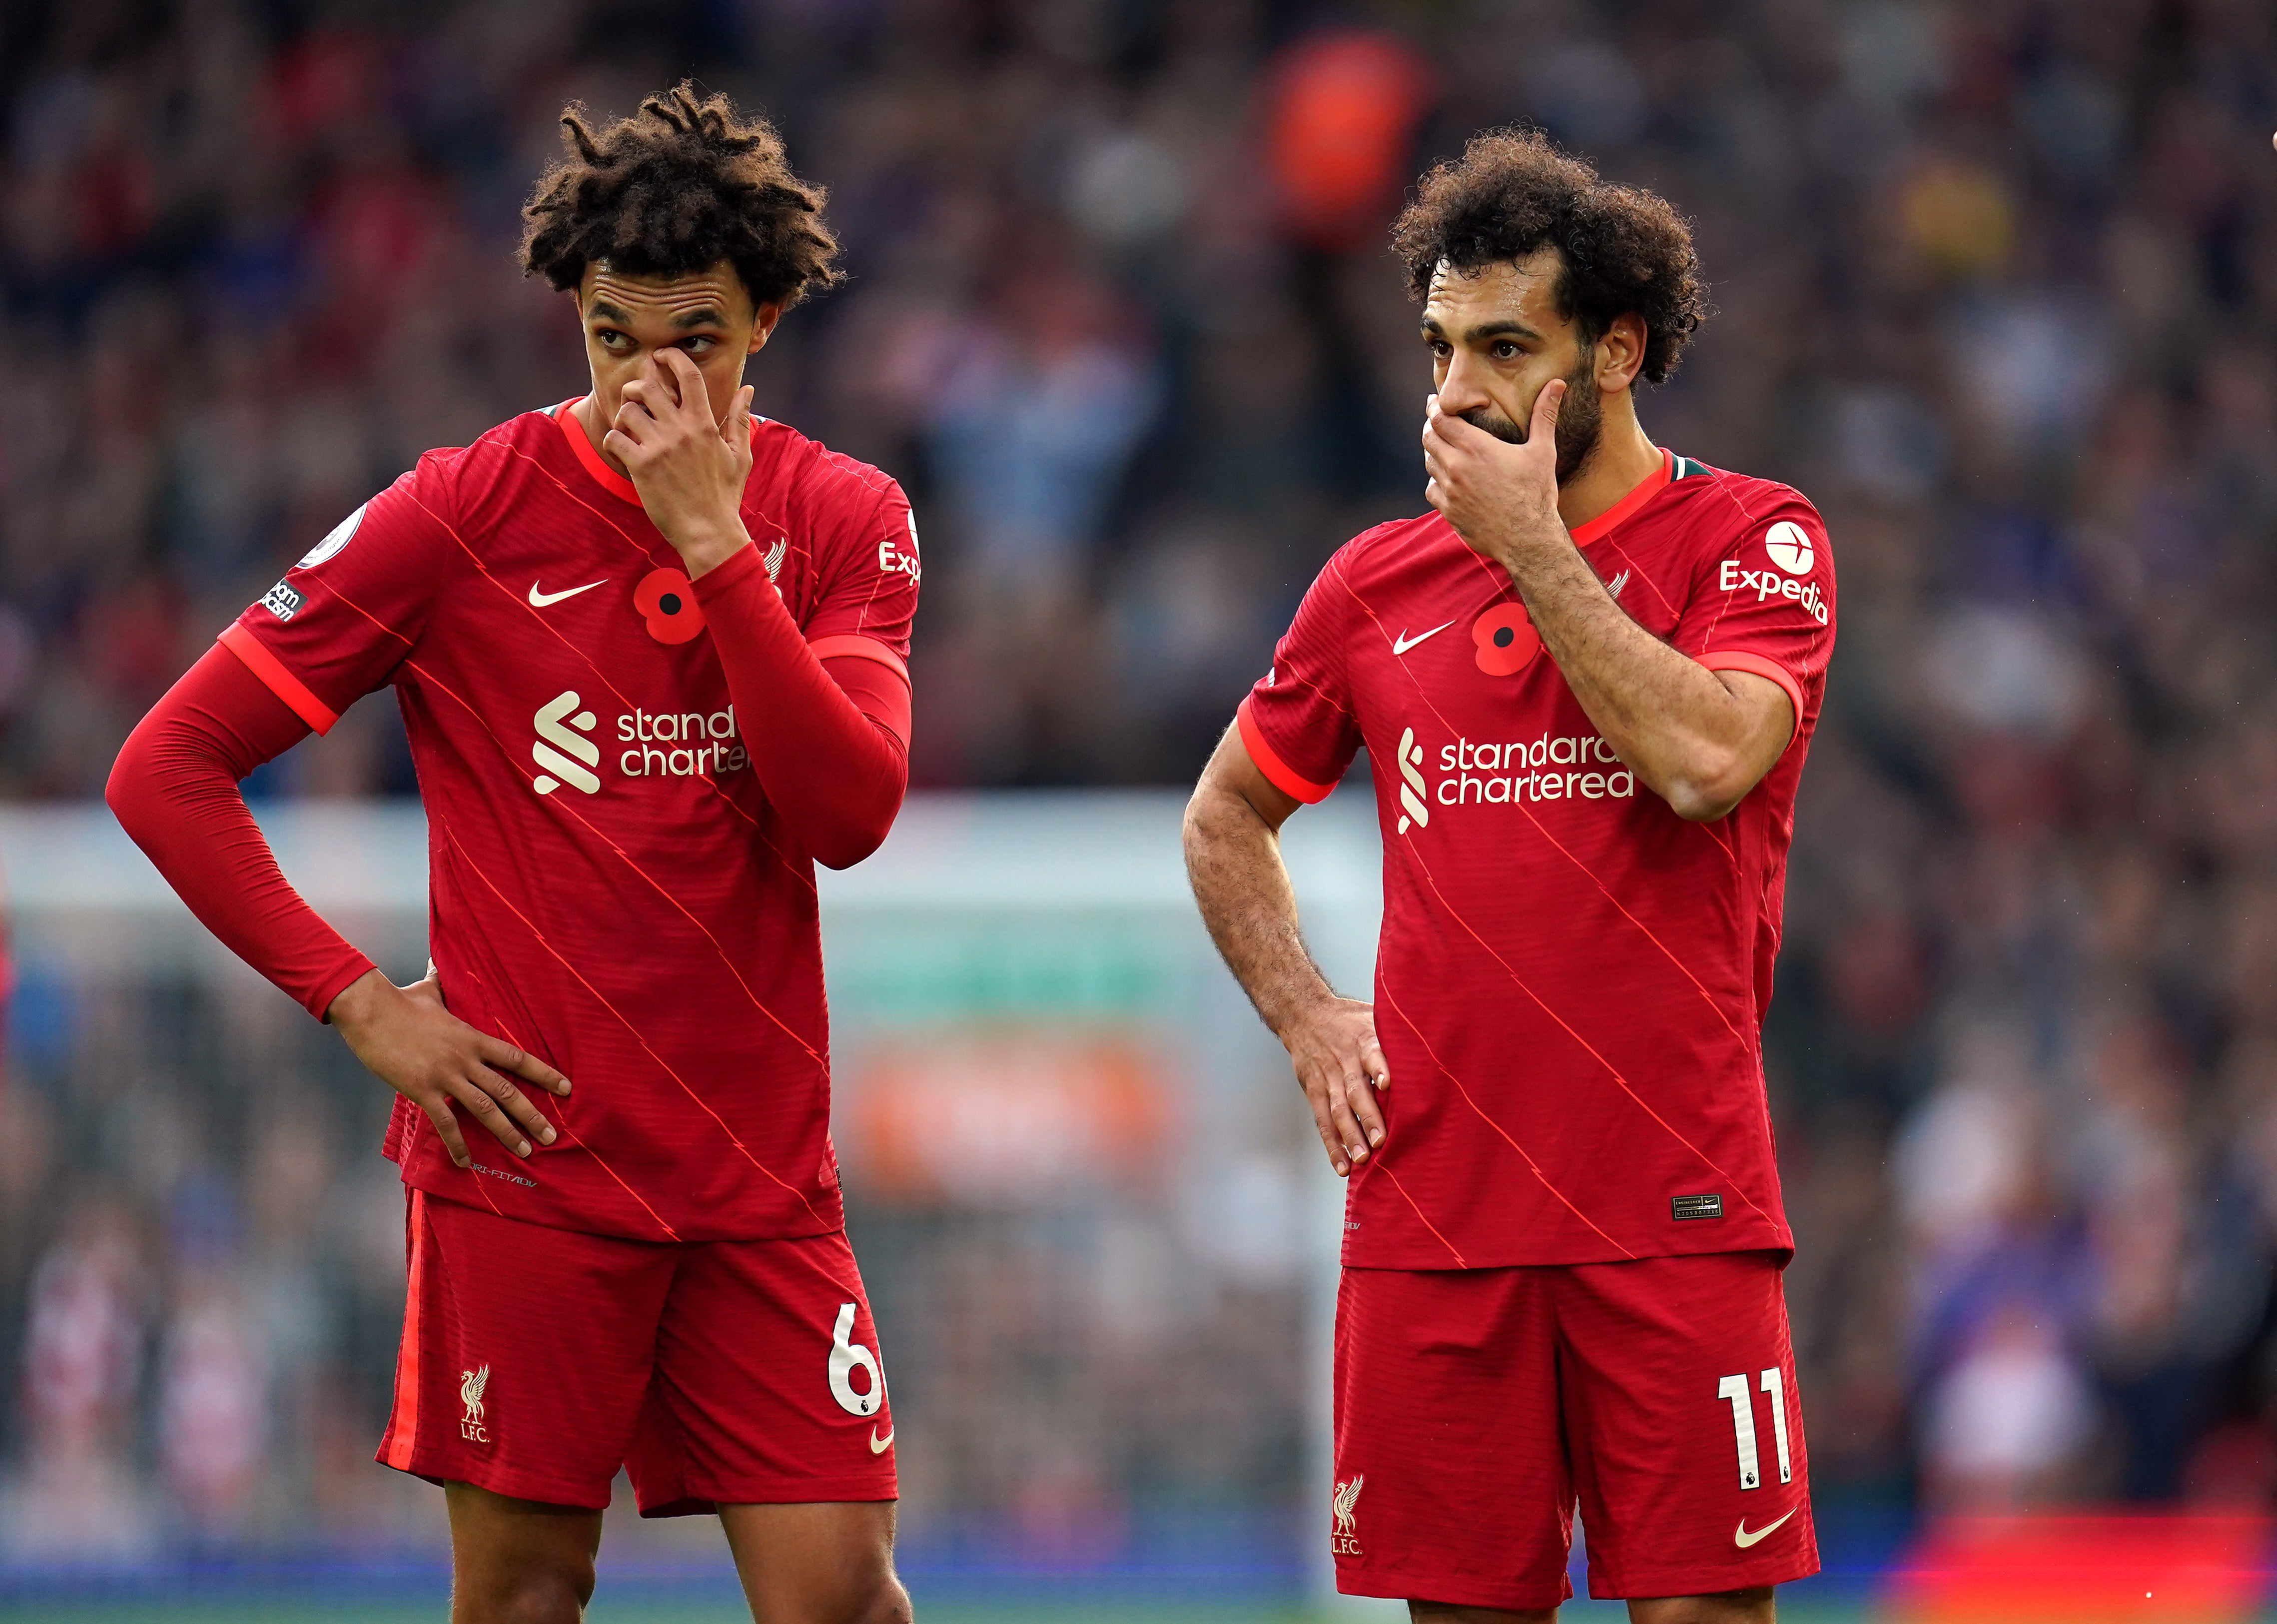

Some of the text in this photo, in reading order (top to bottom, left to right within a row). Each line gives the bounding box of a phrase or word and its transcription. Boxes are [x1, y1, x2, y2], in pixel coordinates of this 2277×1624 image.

[879, 541, 921, 590] Exp
[1720, 560, 1827, 625] Expedia
[617, 704, 736, 741] stand
[1437, 769, 1633, 805] chartered
[828, 1303, 882, 1416] 6
[460, 1423, 490, 1443] L.F.C.
[1717, 1367, 1792, 1491] 11
[1332, 1537, 1363, 1555] L.F.C.
